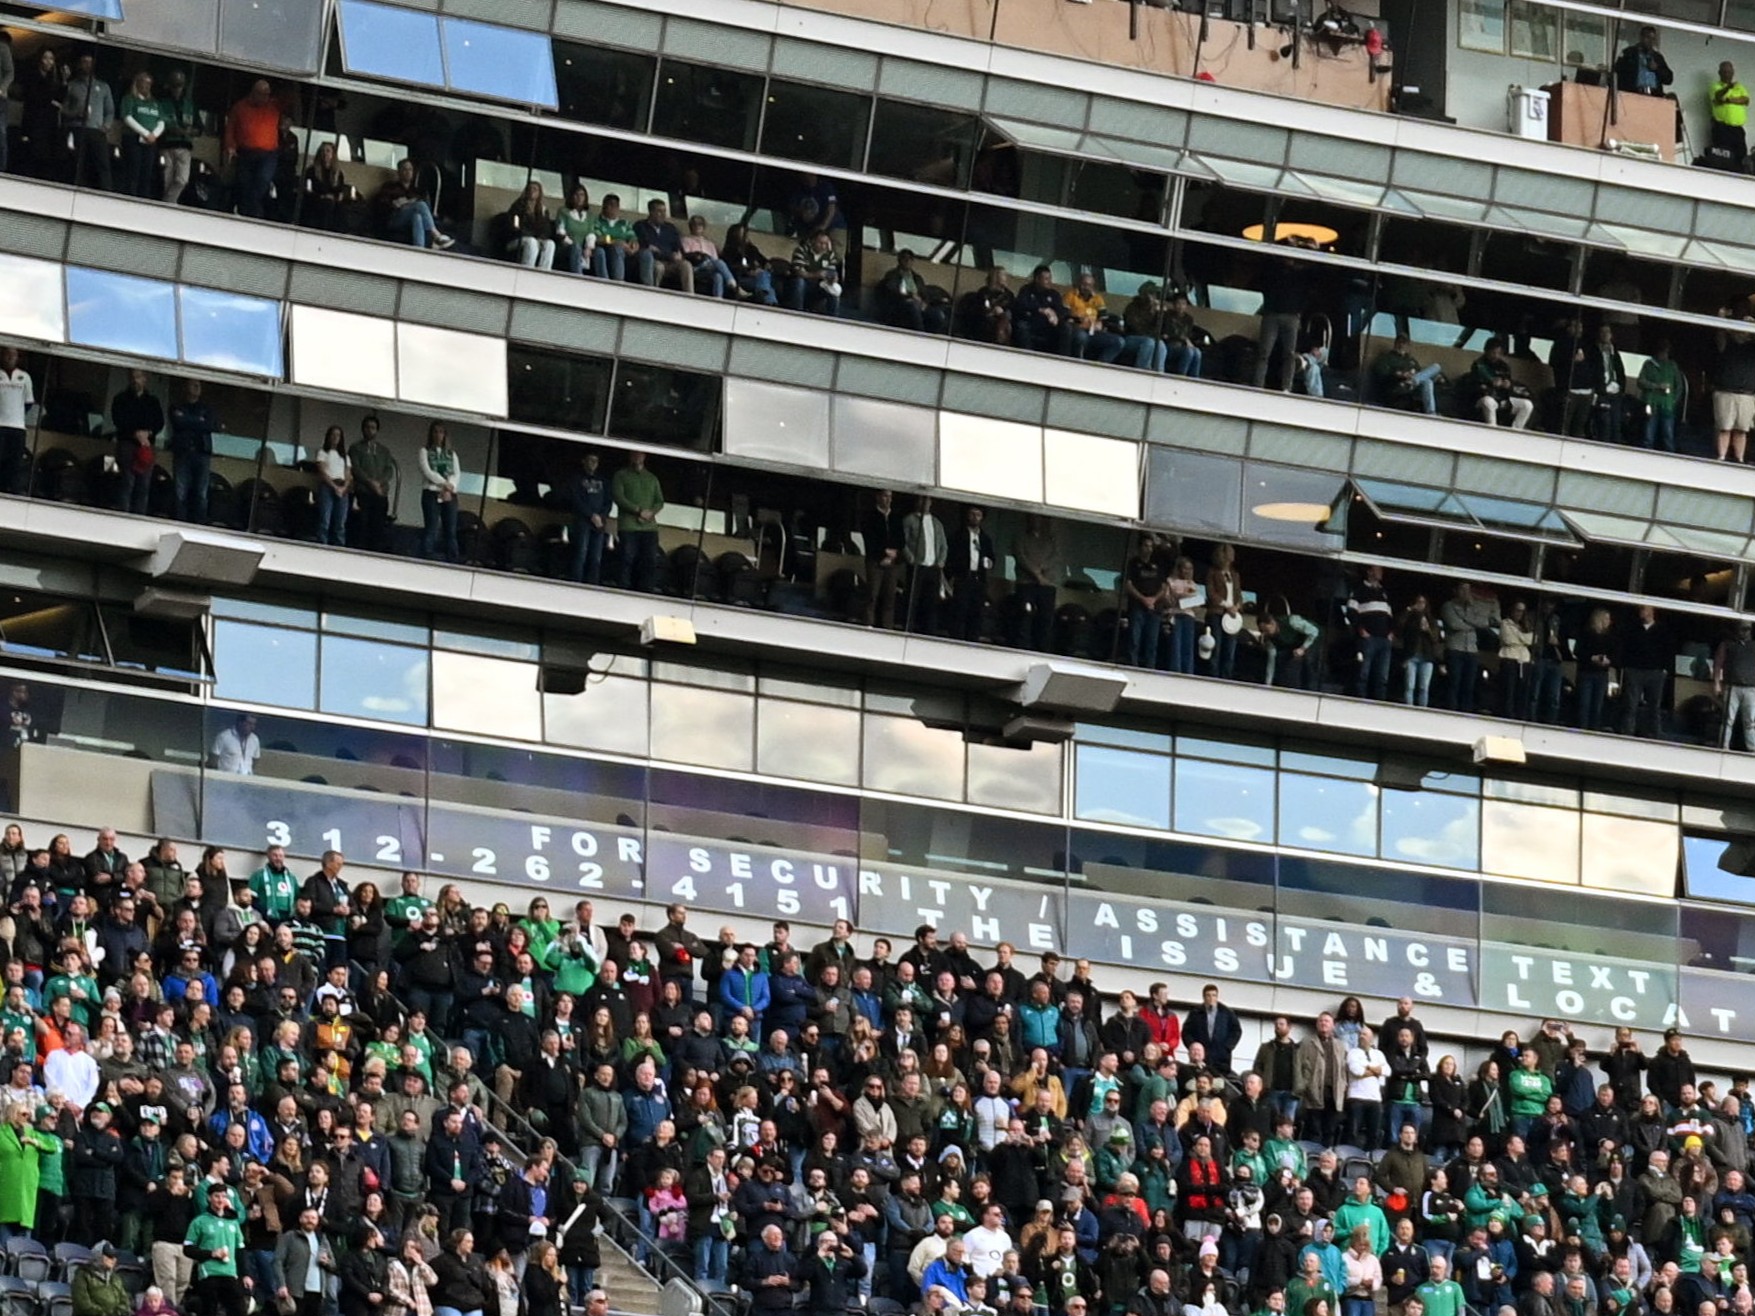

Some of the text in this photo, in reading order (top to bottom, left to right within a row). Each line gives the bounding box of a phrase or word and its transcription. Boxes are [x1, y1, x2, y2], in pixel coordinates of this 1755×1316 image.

[265, 821, 850, 919] 312-262-4151
[916, 905, 1054, 949] THE
[1120, 934, 1348, 985] ISSUE
[1413, 972, 1443, 997] &
[531, 826, 643, 863] FOR
[688, 846, 991, 912] SECURITY
[1093, 901, 1469, 972] ASSISTANCE
[1512, 956, 1651, 994] TEXT
